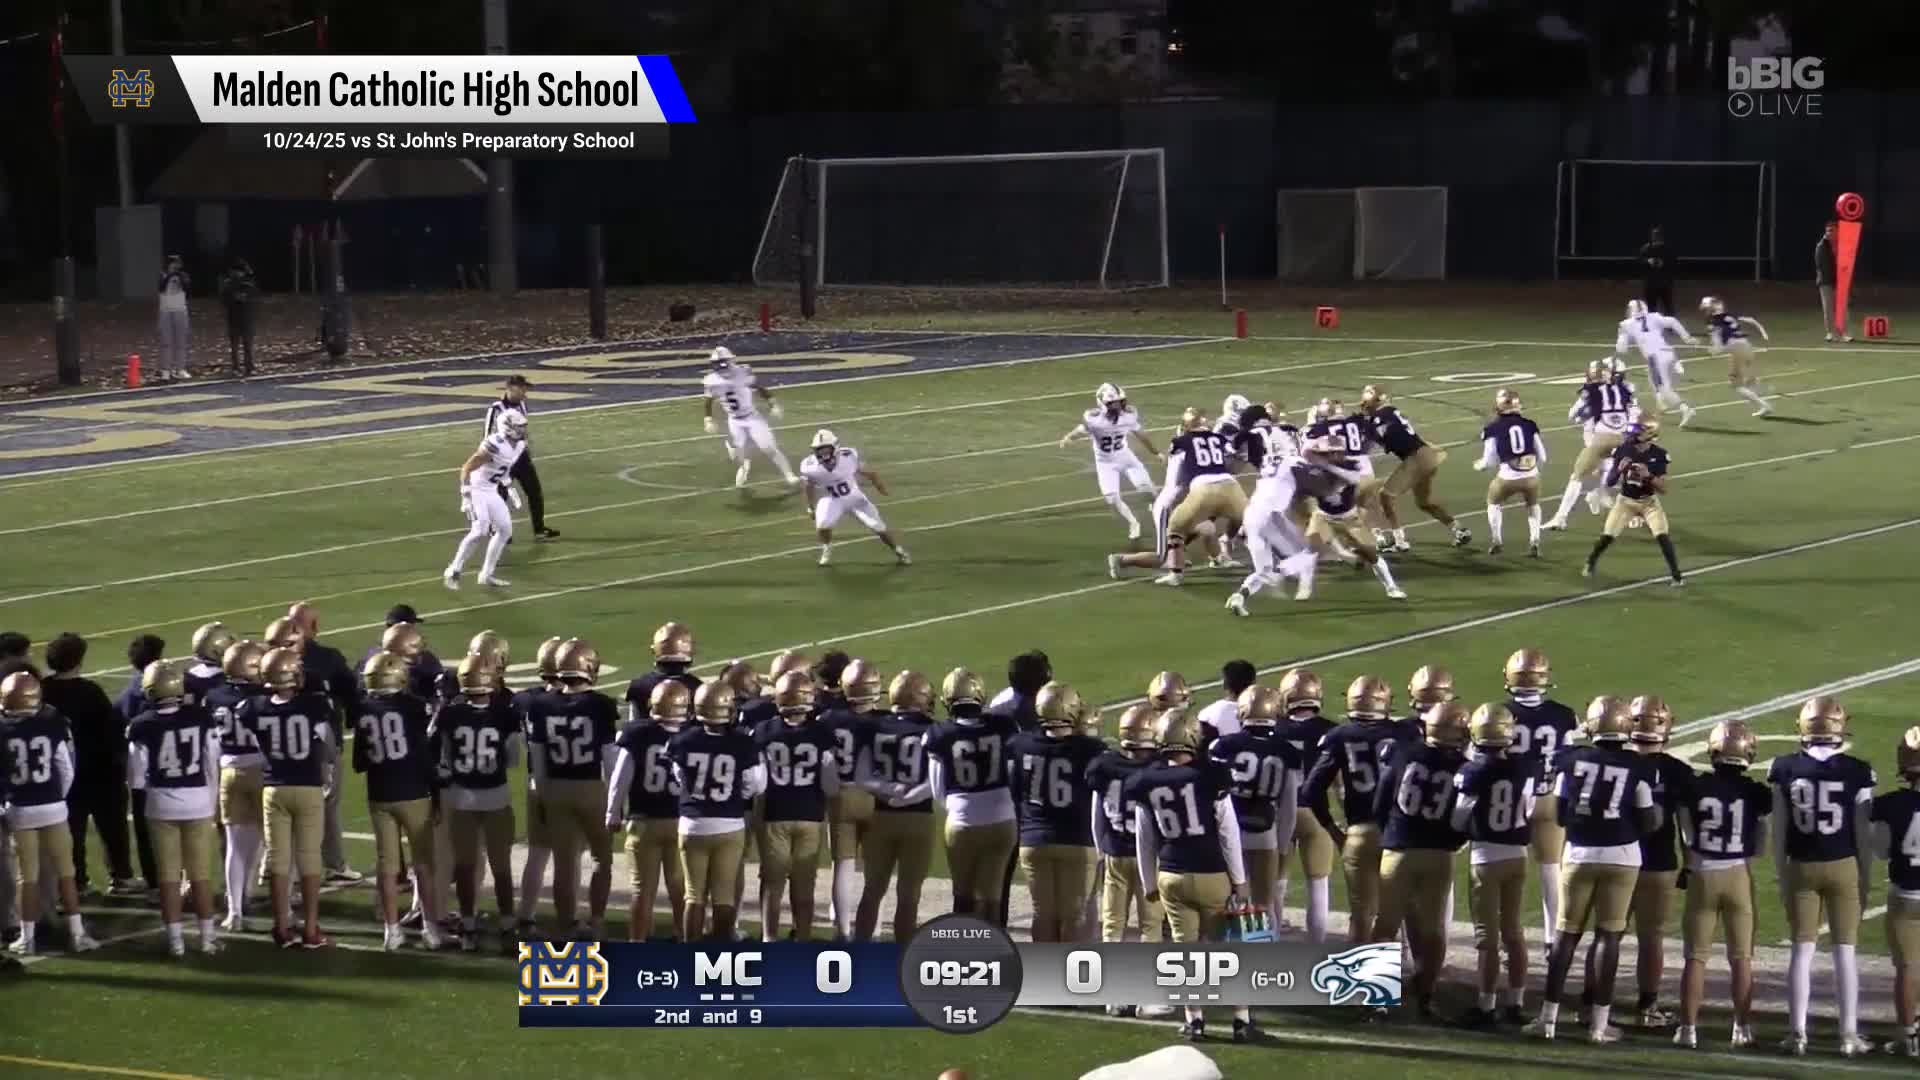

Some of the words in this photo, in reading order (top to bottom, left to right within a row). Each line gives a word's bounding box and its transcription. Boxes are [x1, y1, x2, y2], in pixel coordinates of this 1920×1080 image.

[1868, 318, 1886, 337] 10
[1599, 384, 1624, 411] 11
[1101, 435, 1125, 453] 22
[1192, 437, 1223, 467] 66
[1509, 425, 1525, 454] 0
[8, 736, 52, 785] 33
[159, 727, 201, 778] 47
[258, 714, 310, 760] 70
[360, 711, 408, 763] 38
[454, 725, 500, 774] 36
[547, 716, 594, 765] 52
[874, 733, 922, 784] 59
[953, 736, 1001, 787] 67
[686, 752, 736, 802] 79
[766, 742, 818, 787] 82
[1023, 754, 1073, 807] 76
[1150, 782, 1205, 840] 61
[1397, 761, 1453, 820] 63
[1574, 760, 1629, 820] 77
[1790, 778, 1844, 835] 85
[1699, 797, 1744, 853] 21
